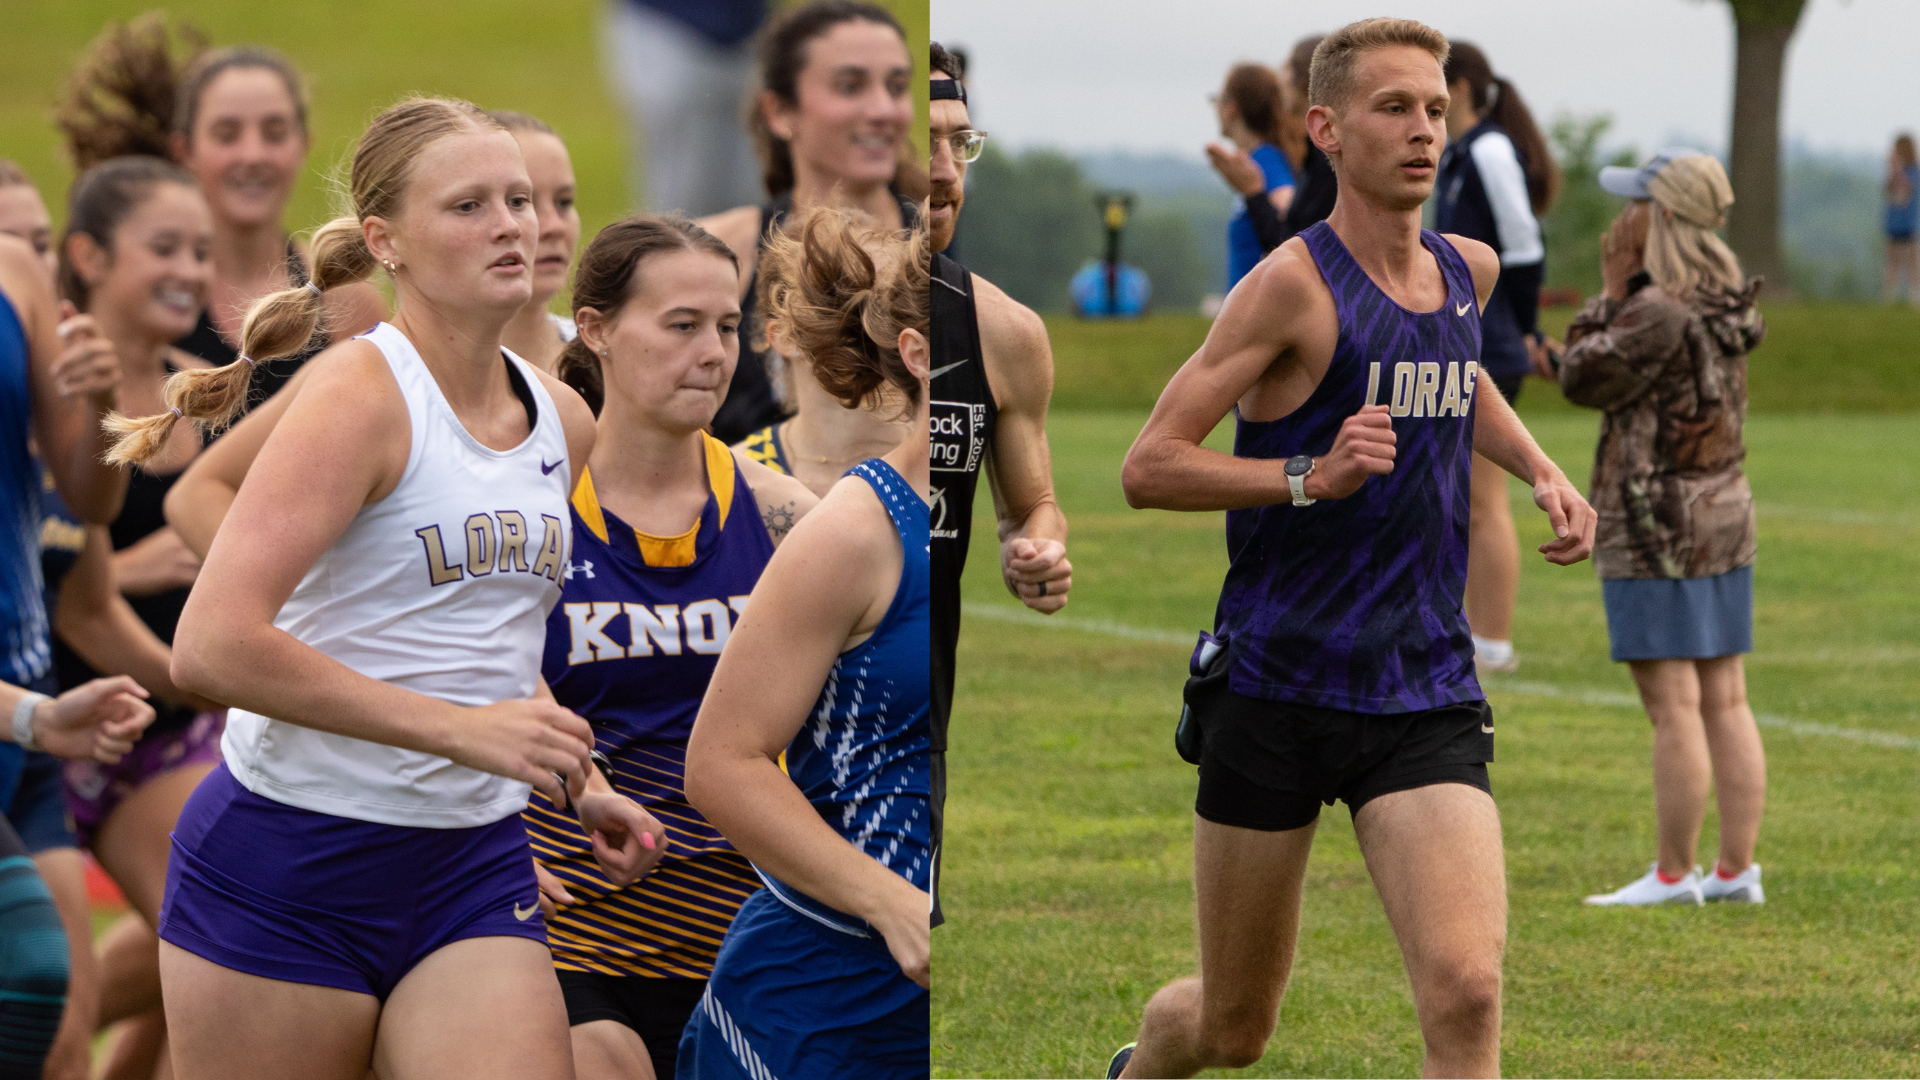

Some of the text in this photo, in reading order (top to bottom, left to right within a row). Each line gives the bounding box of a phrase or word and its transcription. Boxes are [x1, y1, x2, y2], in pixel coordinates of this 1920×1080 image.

[968, 404, 986, 472] Est. 2020
[414, 510, 573, 591] LORA
